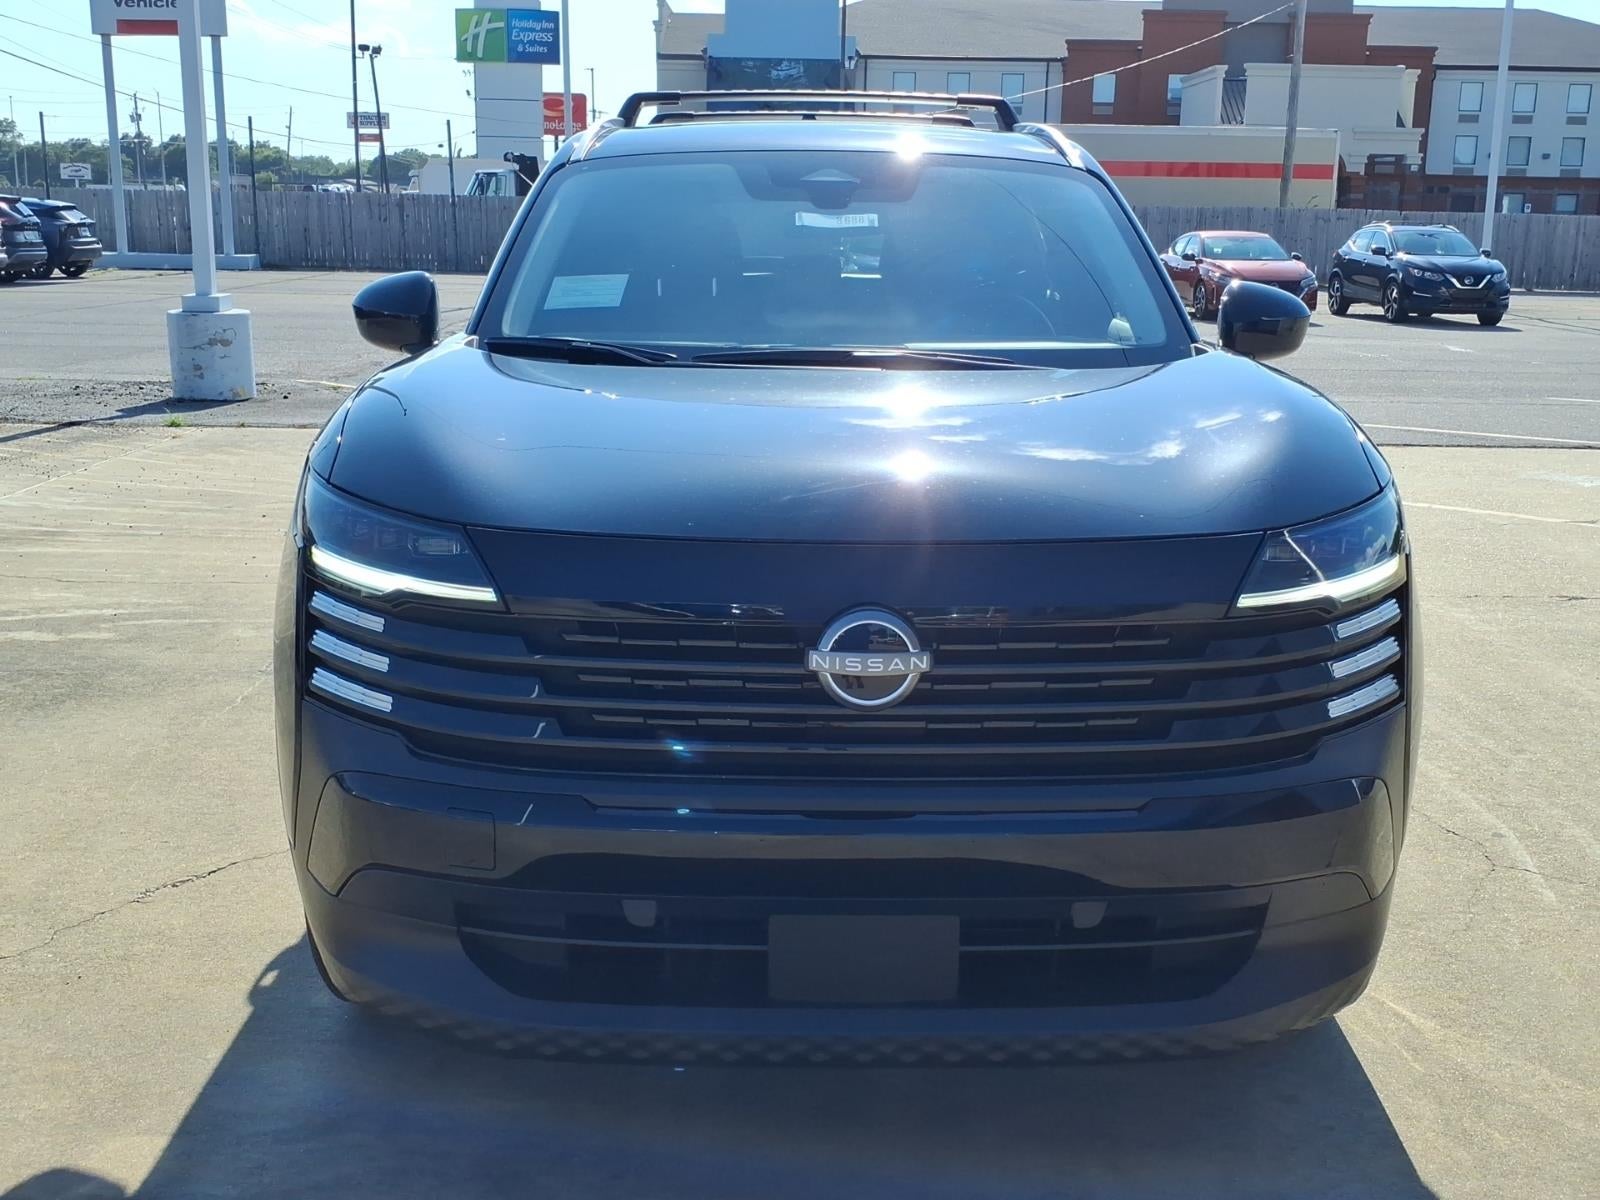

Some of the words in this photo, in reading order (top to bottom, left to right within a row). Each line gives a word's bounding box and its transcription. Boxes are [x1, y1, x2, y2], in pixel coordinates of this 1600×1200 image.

[511, 17, 541, 30] Holiday
[542, 19, 554, 29] Inn
[511, 28, 553, 43] Express
[516, 43, 523, 52] &
[525, 43, 548, 53] Suites
[812, 654, 927, 672] NISSAN
